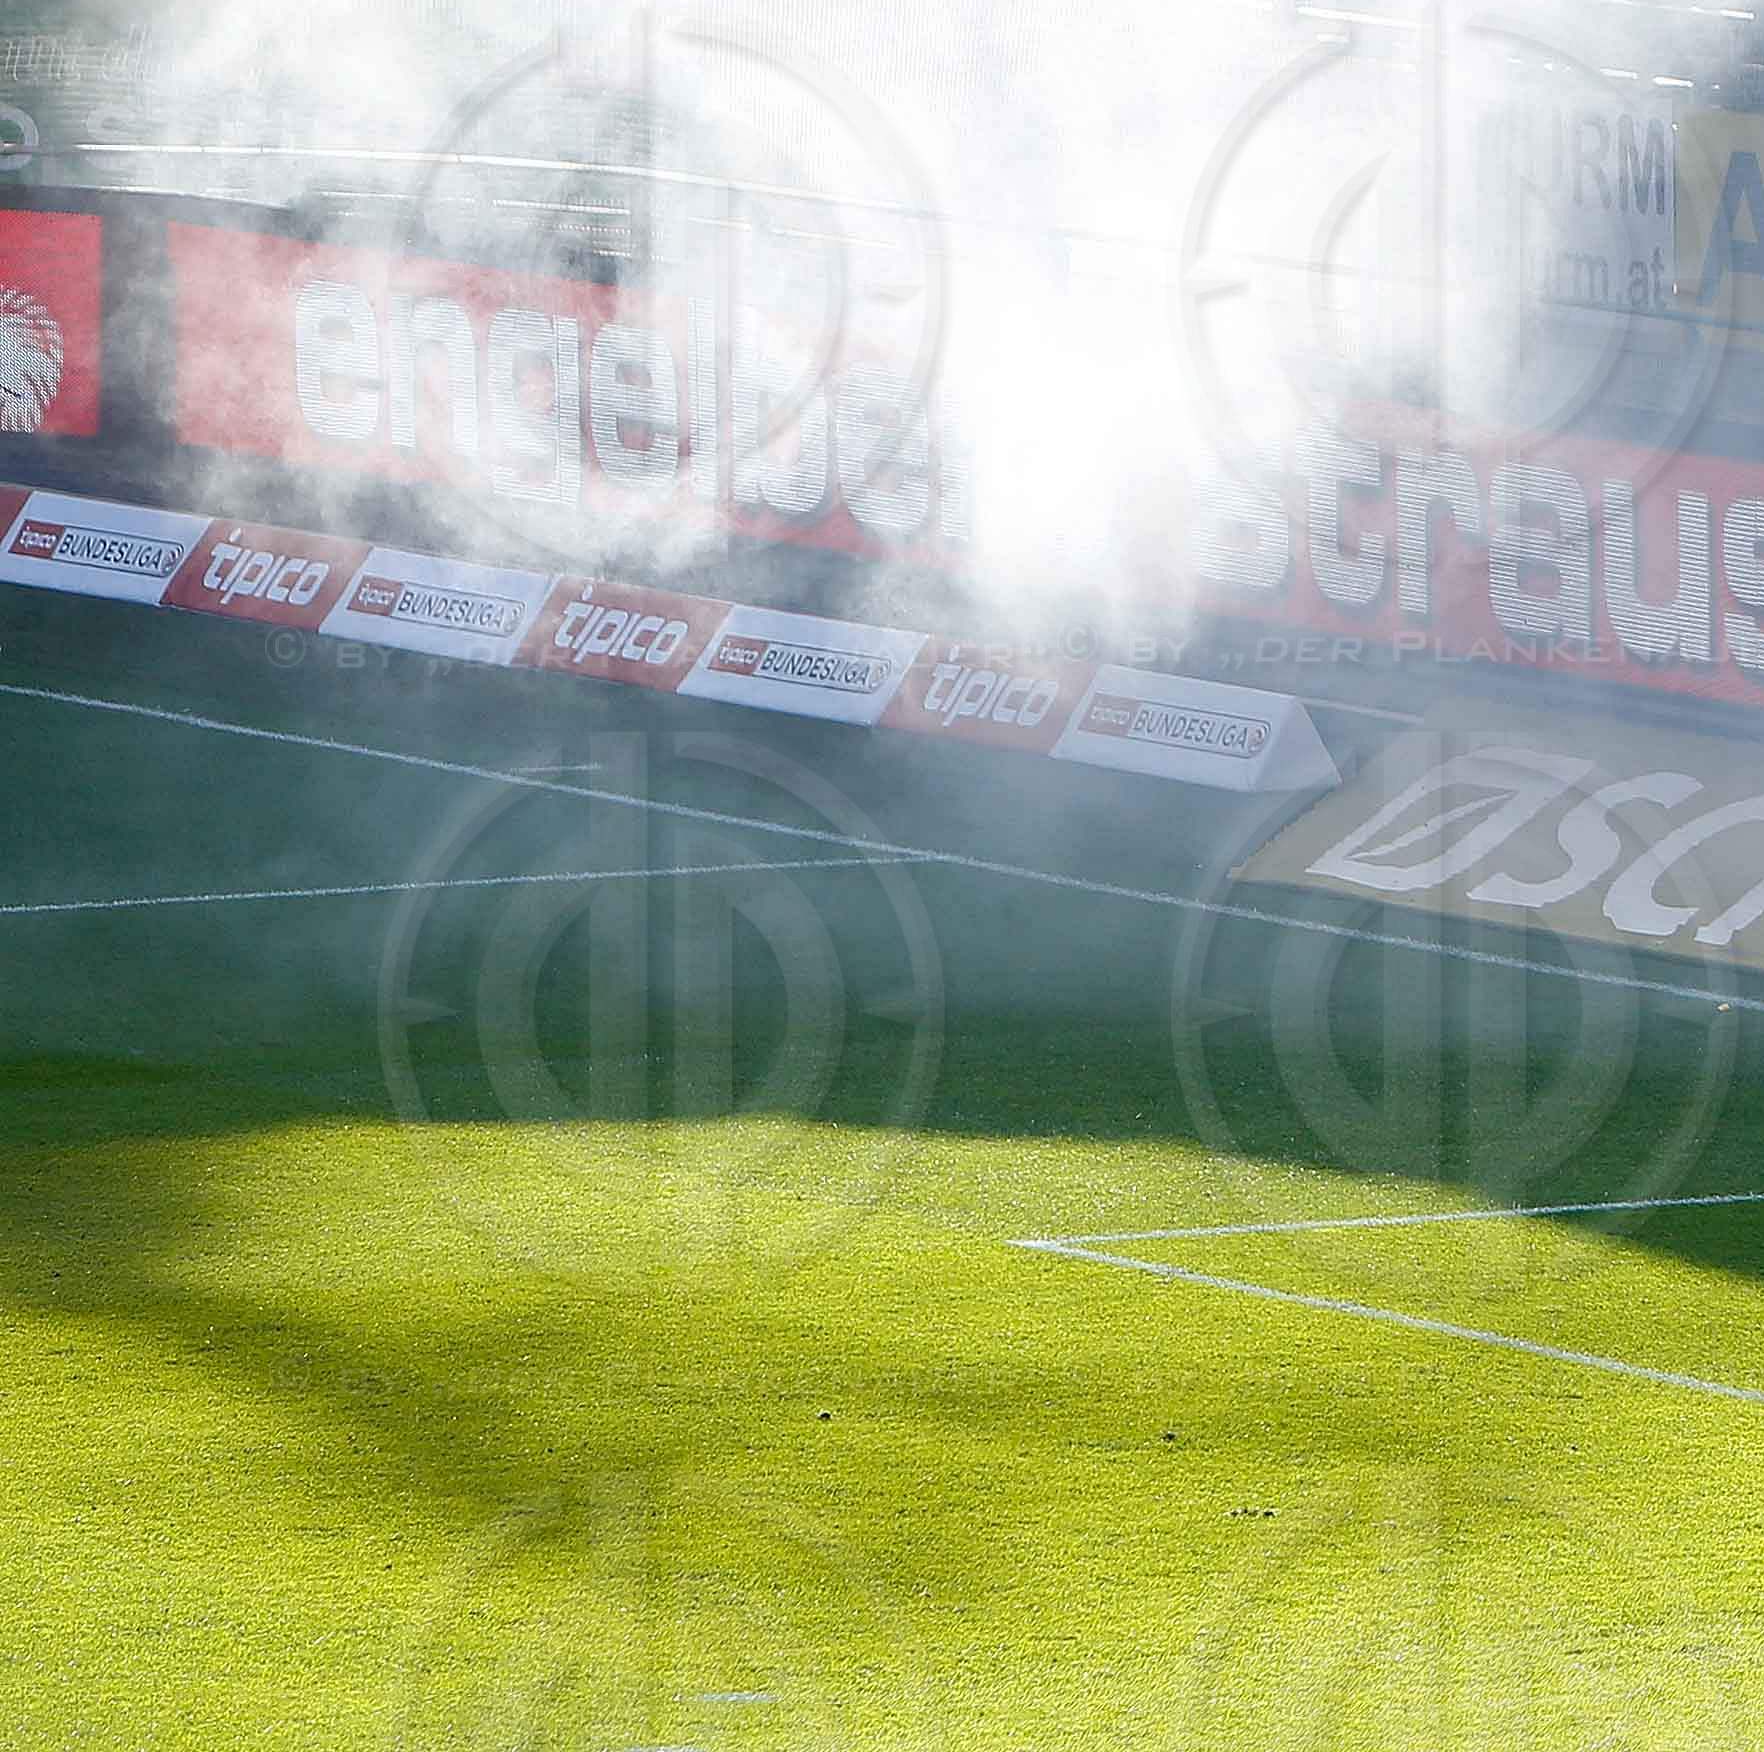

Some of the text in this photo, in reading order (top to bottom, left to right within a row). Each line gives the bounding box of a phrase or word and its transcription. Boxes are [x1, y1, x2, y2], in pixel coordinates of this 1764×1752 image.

[58, 533, 163, 571] BUNDESLIGA
[202, 527, 330, 605] tipico
[398, 590, 505, 630] BUNDESLIGA
[553, 583, 689, 665] tipico
[760, 648, 870, 685] BUNDESLIGA
[923, 643, 1060, 728] tipico
[1132, 708, 1251, 750] BUNDESLIGA
